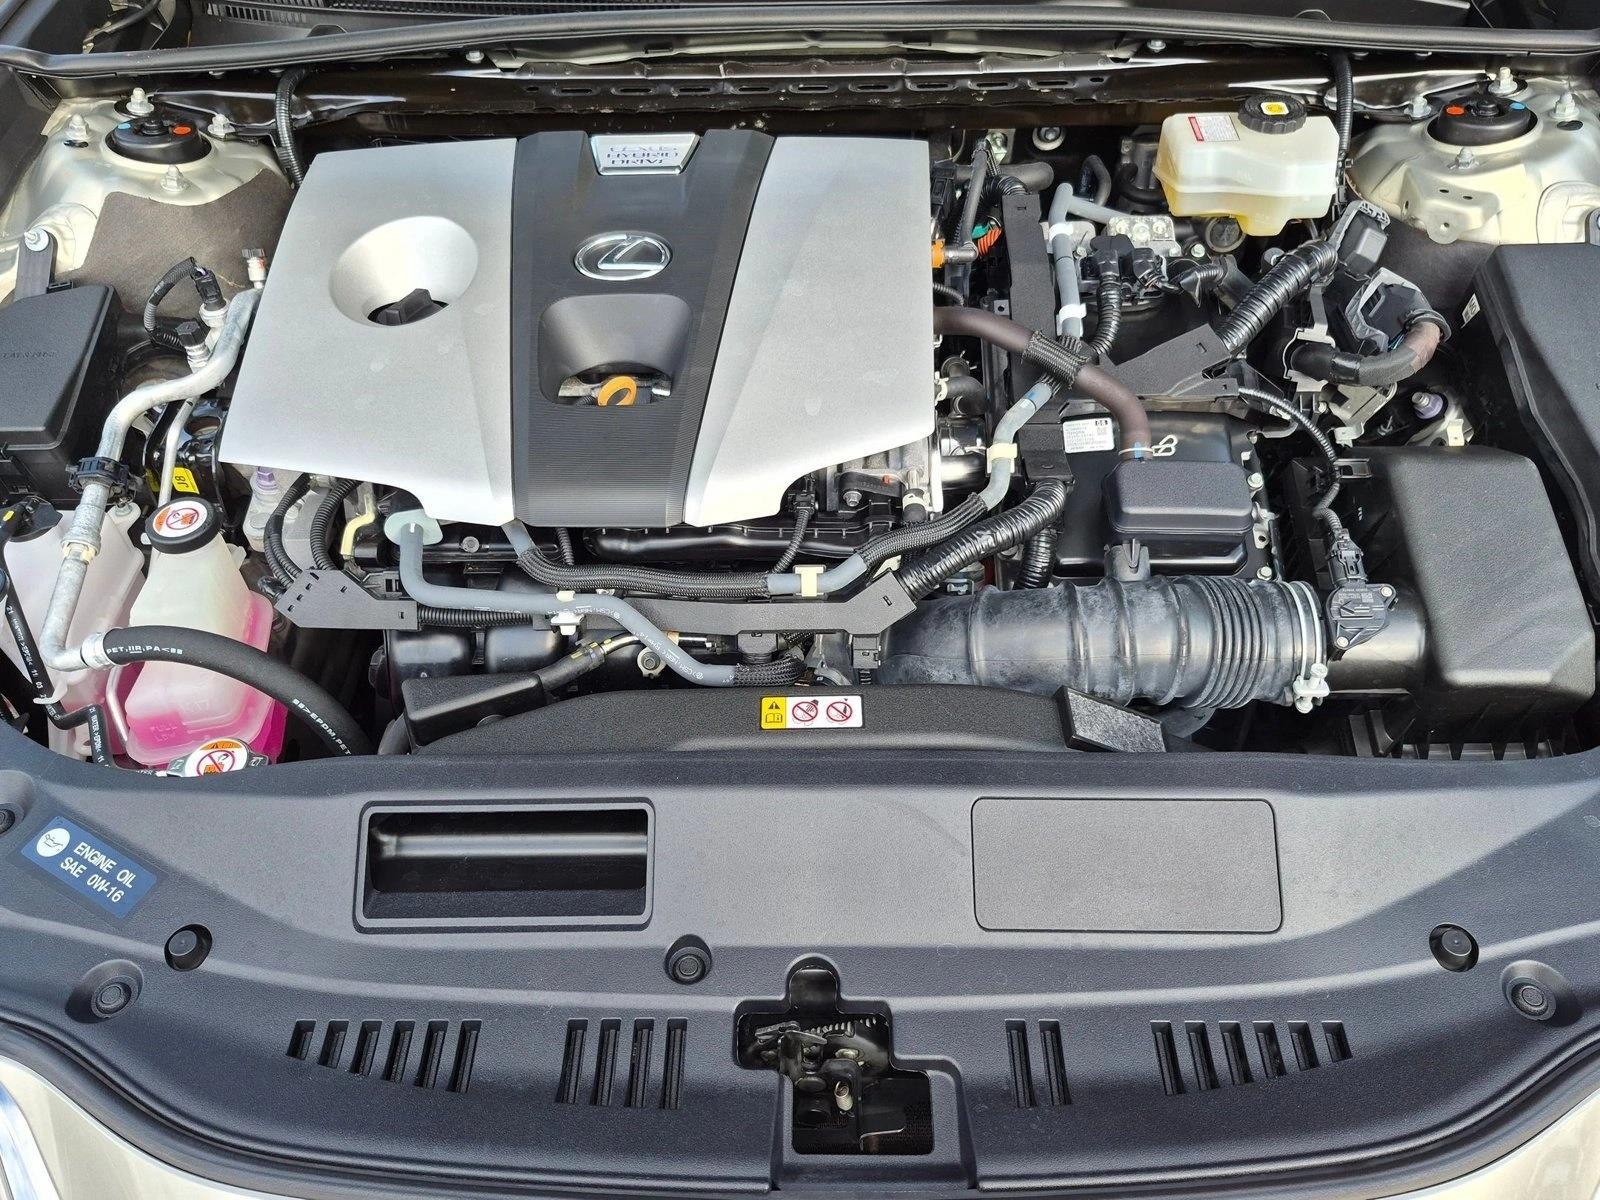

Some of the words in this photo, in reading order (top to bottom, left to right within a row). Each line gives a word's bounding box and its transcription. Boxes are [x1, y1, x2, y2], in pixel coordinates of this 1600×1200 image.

[60, 856, 88, 878] SAE
[86, 874, 125, 902] 0W-16
[73, 841, 118, 874] ENGINE
[116, 869, 136, 889] OIL
